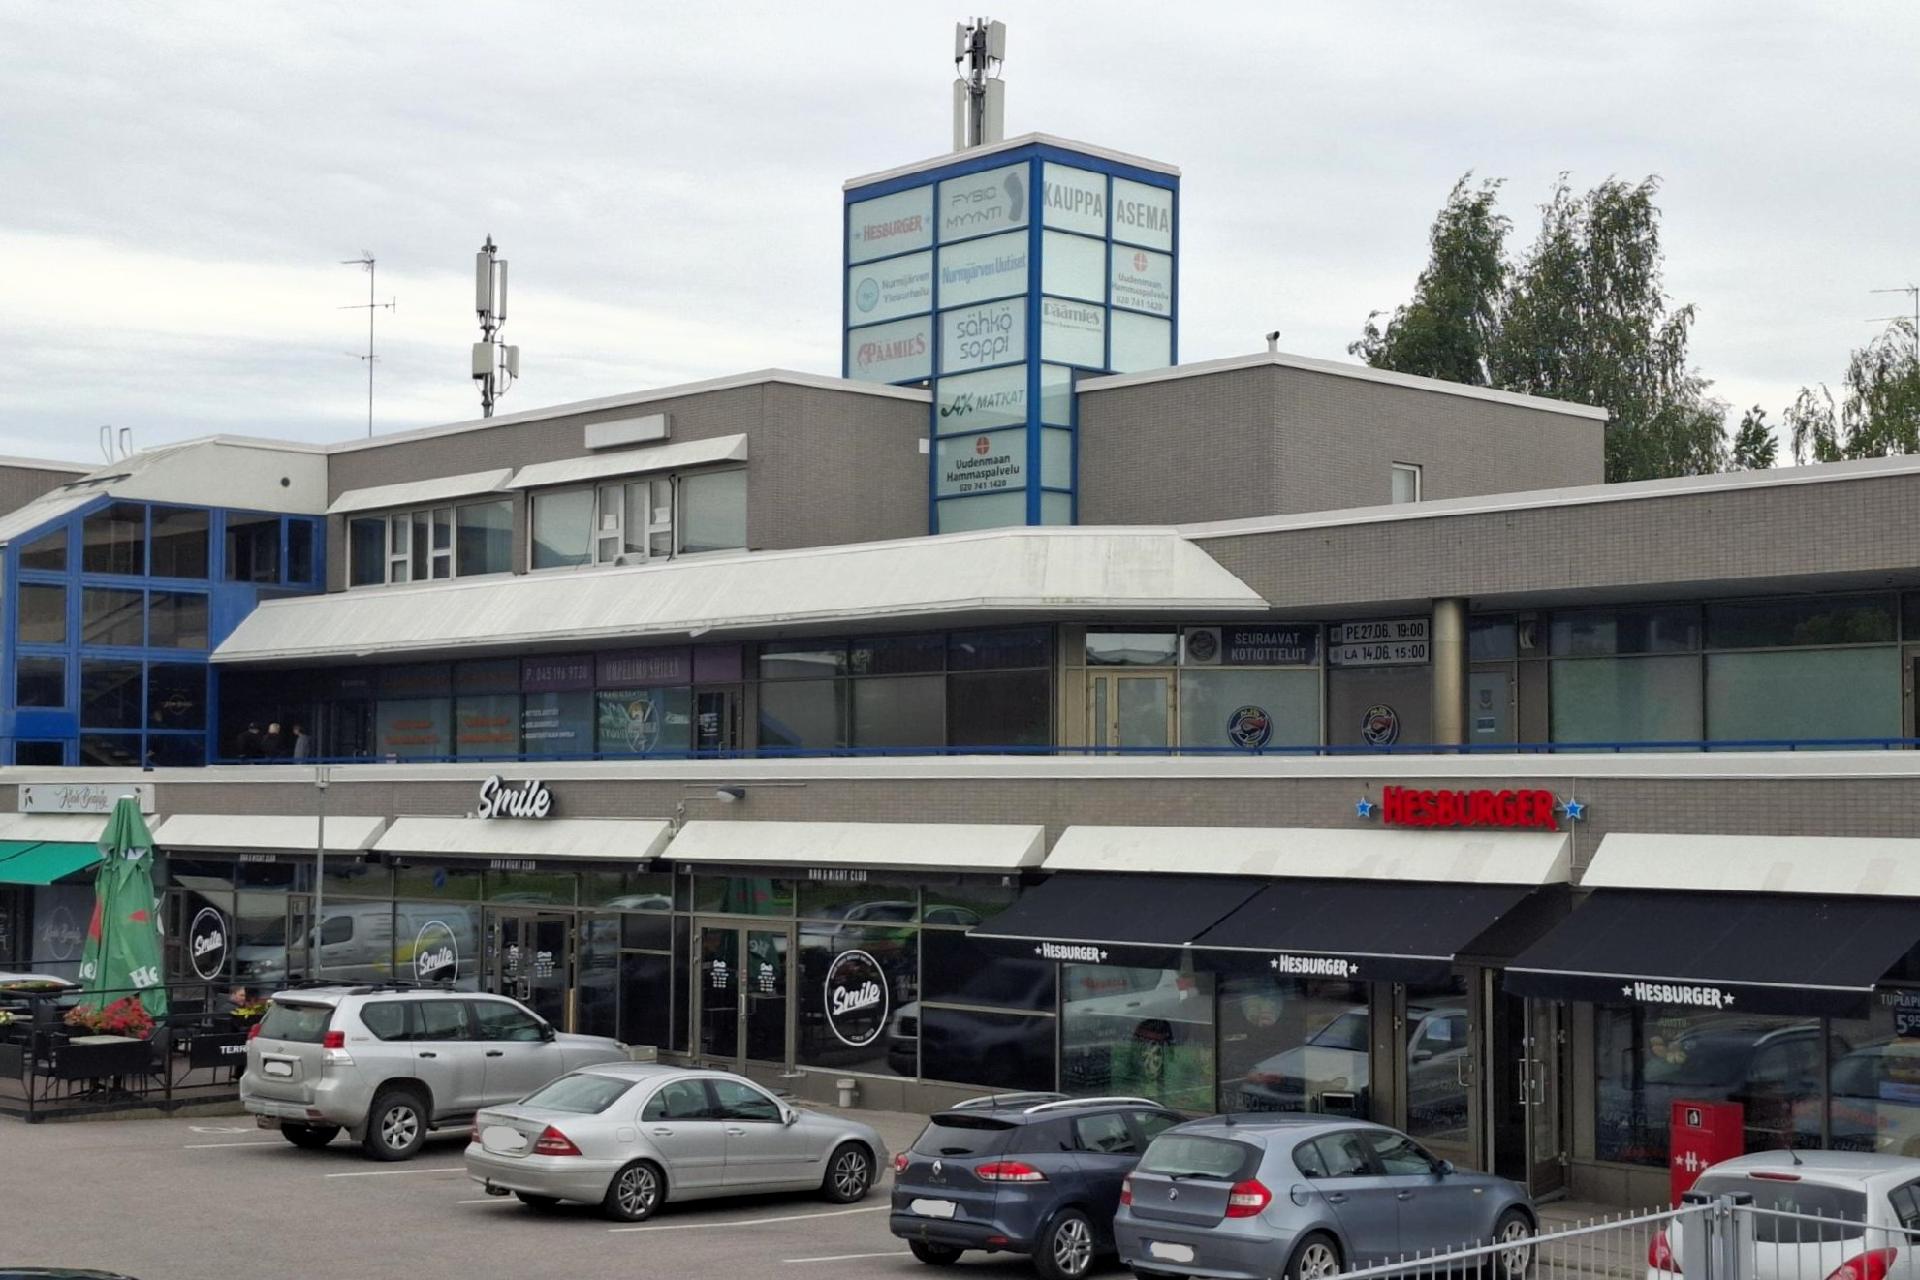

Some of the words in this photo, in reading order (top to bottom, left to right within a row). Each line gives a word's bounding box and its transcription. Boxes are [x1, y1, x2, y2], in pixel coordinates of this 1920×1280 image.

[1044, 181, 1103, 218] KAUPPA
[864, 215, 923, 241] HESBURGER
[946, 206, 1002, 229] MYYNTI
[1117, 199, 1169, 233] ASEMA
[957, 306, 1013, 340] sähkö
[960, 331, 1010, 363] soppi
[976, 390, 1025, 410] MATKAT
[946, 464, 1020, 482] Hammaspalvelu
[956, 455, 1011, 470] Uudenmaan
[1235, 632, 1300, 645] SEURAAVAT
[1346, 625, 1360, 640] PE
[1231, 647, 1306, 660] KOTIOTTELUT
[1344, 649, 1358, 660] LA
[1395, 644, 1425, 658] 15:00
[478, 775, 552, 819] Smile
[1383, 785, 1557, 831] HESBURGER
[194, 929, 223, 957] Smile
[1042, 943, 1100, 963] HESBURGER
[419, 945, 454, 976] Smile
[1279, 954, 1349, 978] HESBURGER
[833, 980, 881, 1015] Smile
[1633, 982, 1723, 1009] HESBURGER
